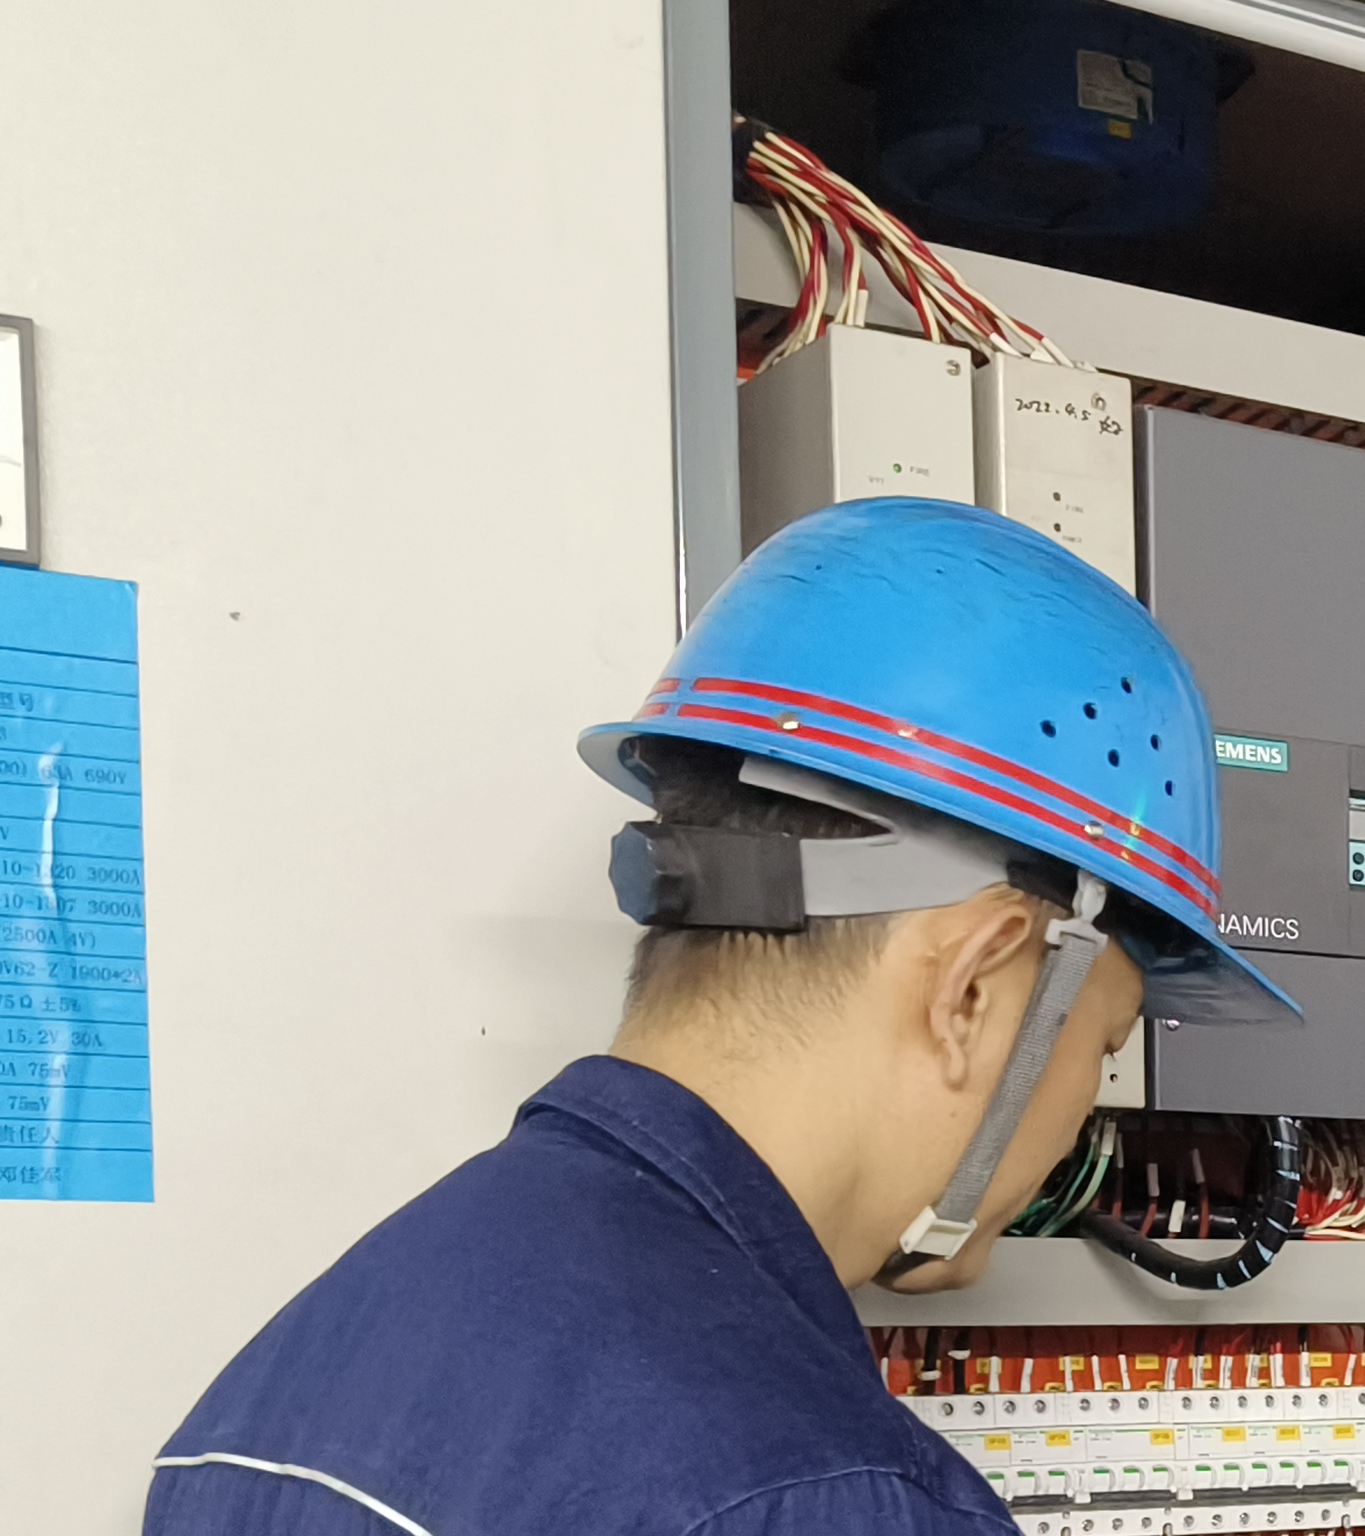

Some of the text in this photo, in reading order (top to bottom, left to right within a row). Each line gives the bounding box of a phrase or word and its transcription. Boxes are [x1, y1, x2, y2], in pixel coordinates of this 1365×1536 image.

[1216, 740, 1282, 764] EMENS
[2, 859, 76, 880] 10-120
[1217, 912, 1299, 940] NAMICS
